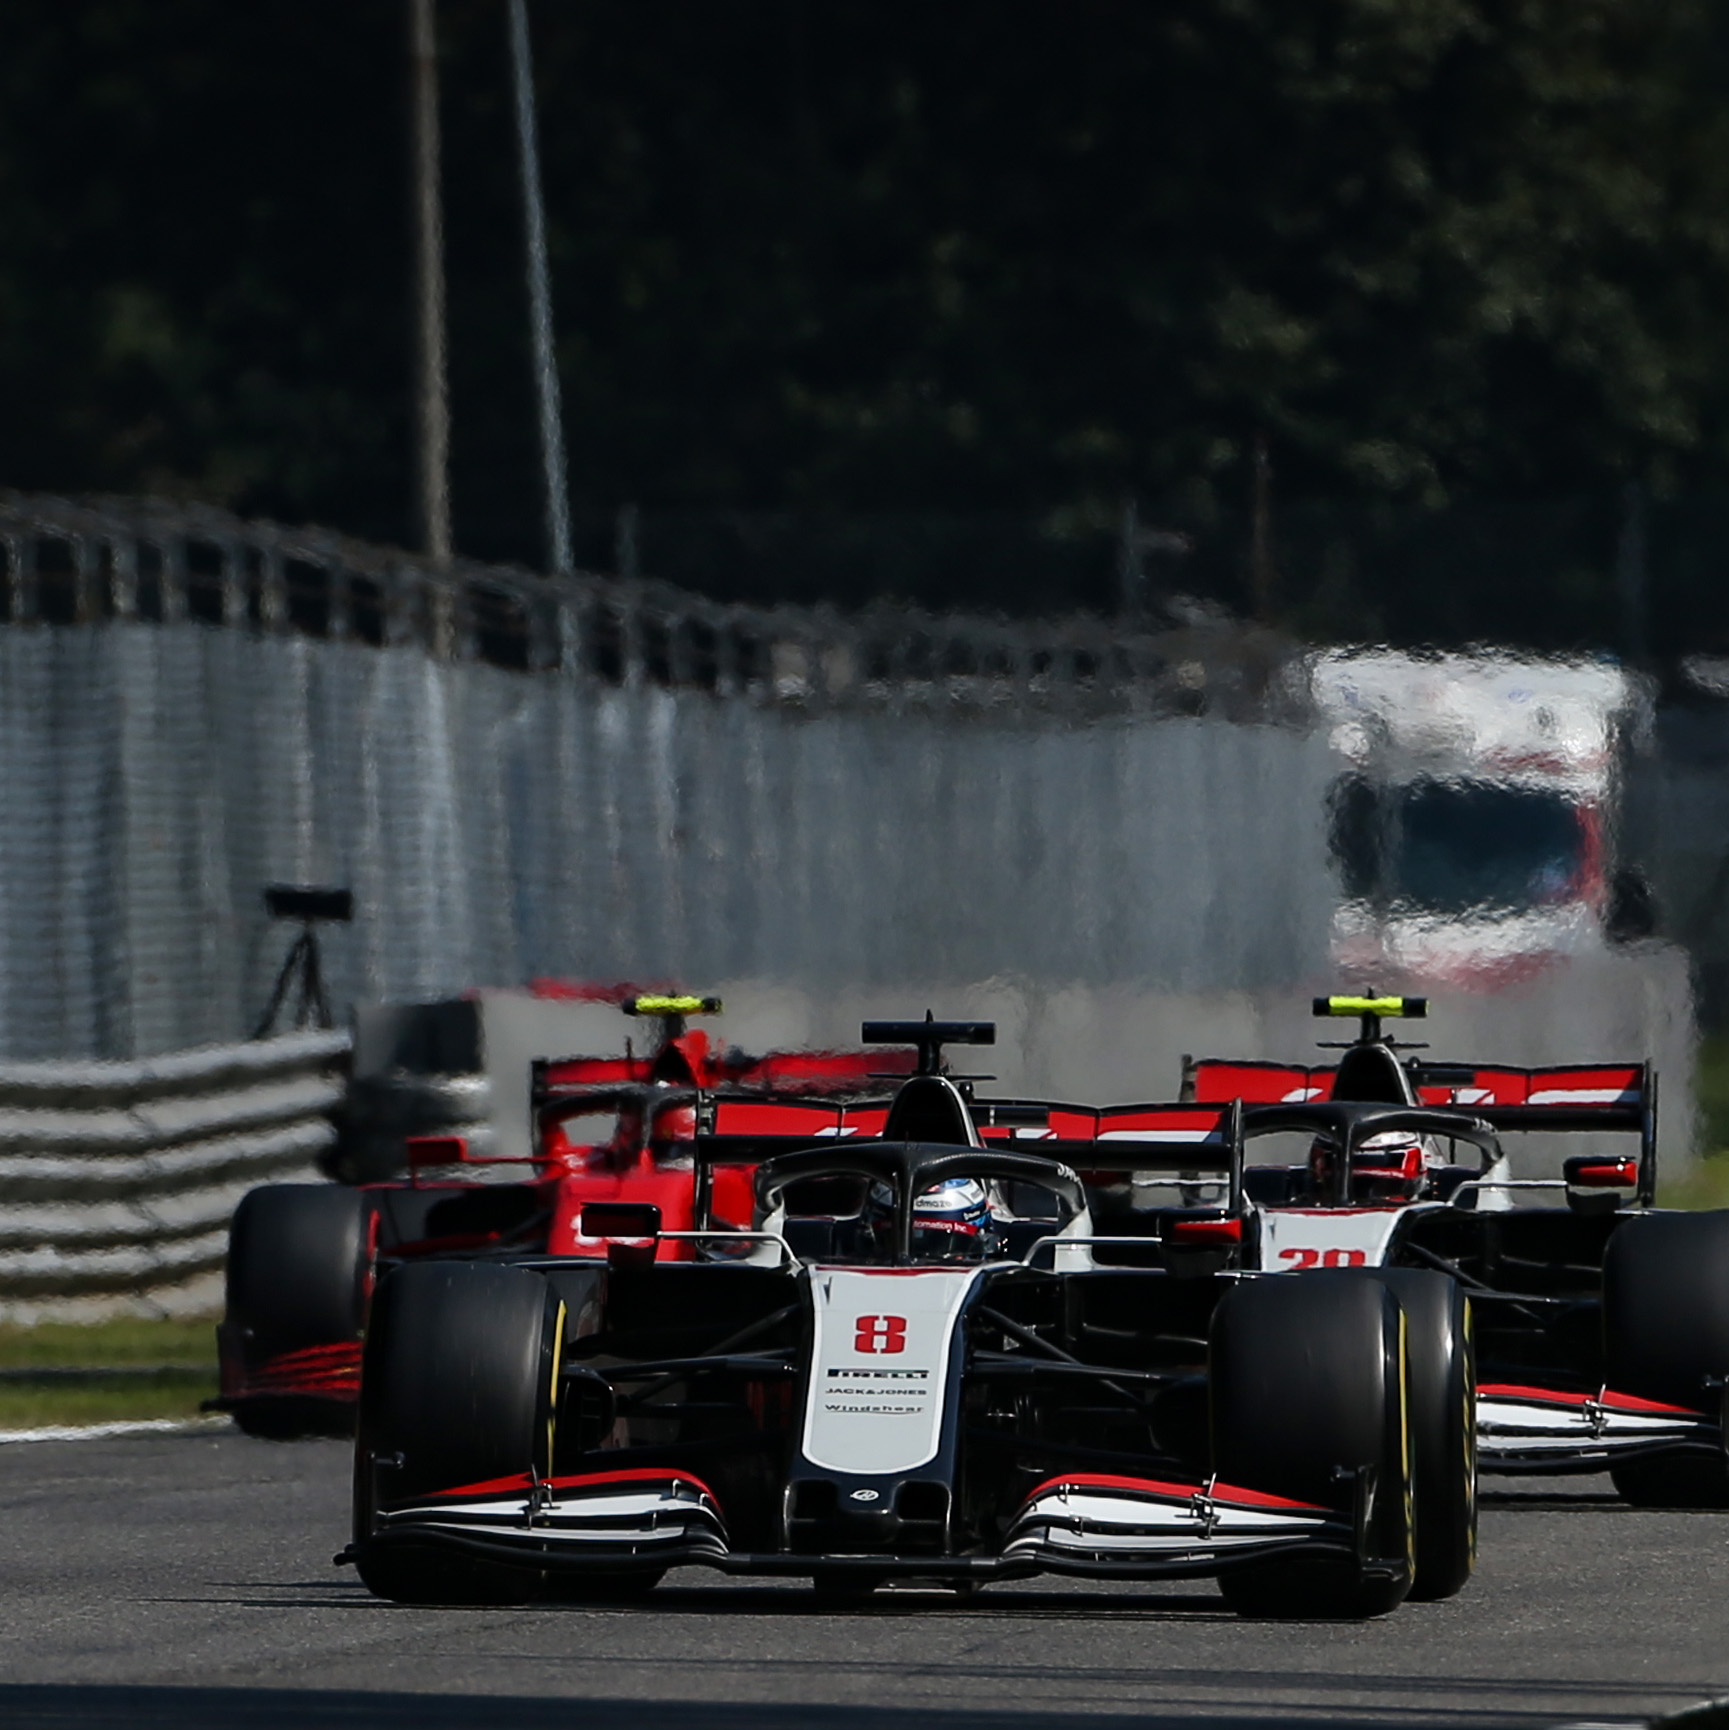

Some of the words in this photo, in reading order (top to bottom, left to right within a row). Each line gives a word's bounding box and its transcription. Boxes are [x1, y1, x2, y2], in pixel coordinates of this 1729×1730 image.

[854, 1315, 907, 1354] 8
[826, 1367, 930, 1379] PIRELLI
[825, 1387, 928, 1396] JACK&JONES
[824, 1404, 925, 1413] Windshear
